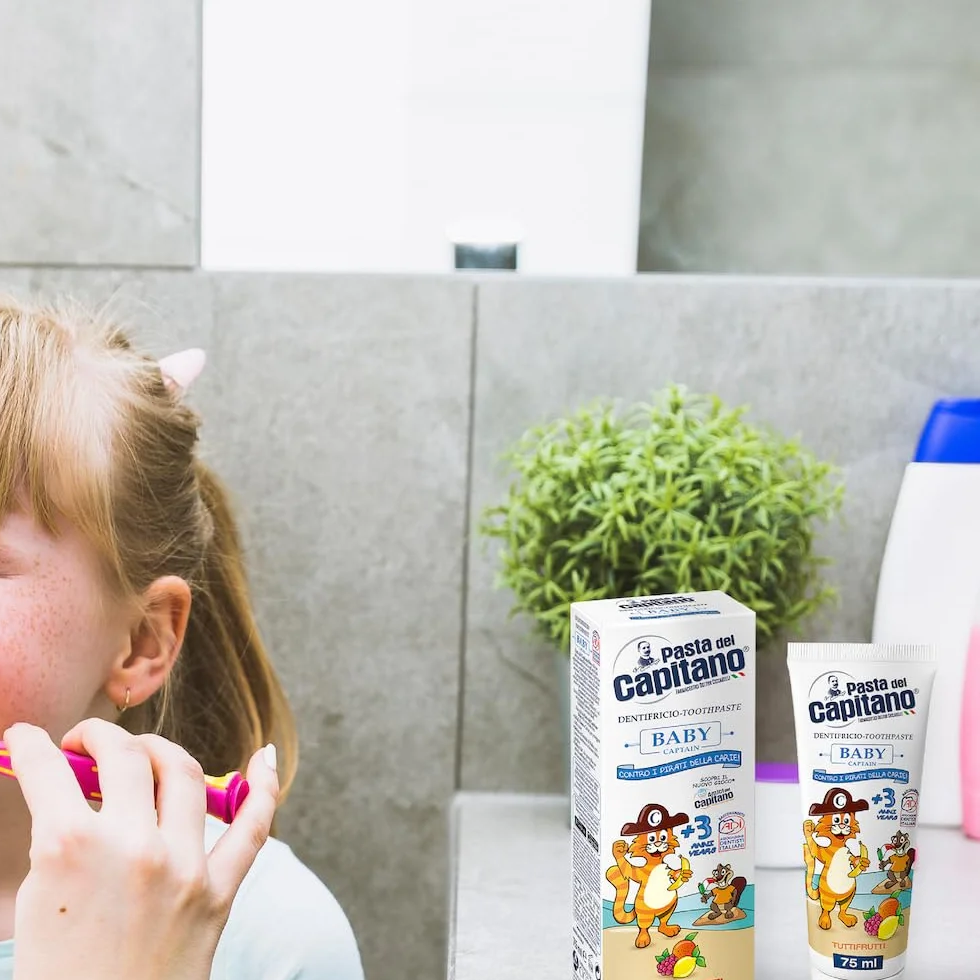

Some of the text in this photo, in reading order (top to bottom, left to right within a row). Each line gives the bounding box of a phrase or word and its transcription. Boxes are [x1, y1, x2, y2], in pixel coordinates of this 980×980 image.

[661, 634, 735, 663] Pasta del
[613, 647, 747, 702] Capitano
[846, 677, 907, 695] Pasta del
[808, 689, 916, 724] Capitano
[651, 726, 712, 748] BABY
[663, 745, 700, 755] CAPTAIN
[839, 747, 886, 760] BABY
[618, 768, 650, 779] CONTRO
[659, 762, 687, 775] PIRATI
[689, 756, 712, 768] DELLA
[692, 781, 713, 789] NUOVO
[836, 794, 845, 807] C
[871, 787, 897, 808] +3
[649, 811, 662, 825] C
[680, 814, 713, 841] +3
[691, 840, 715, 849] ANNI
[688, 847, 717, 857] YEARS
[831, 941, 887, 951] TUTTIFRUTTI
[840, 956, 878, 969] 75 ml
